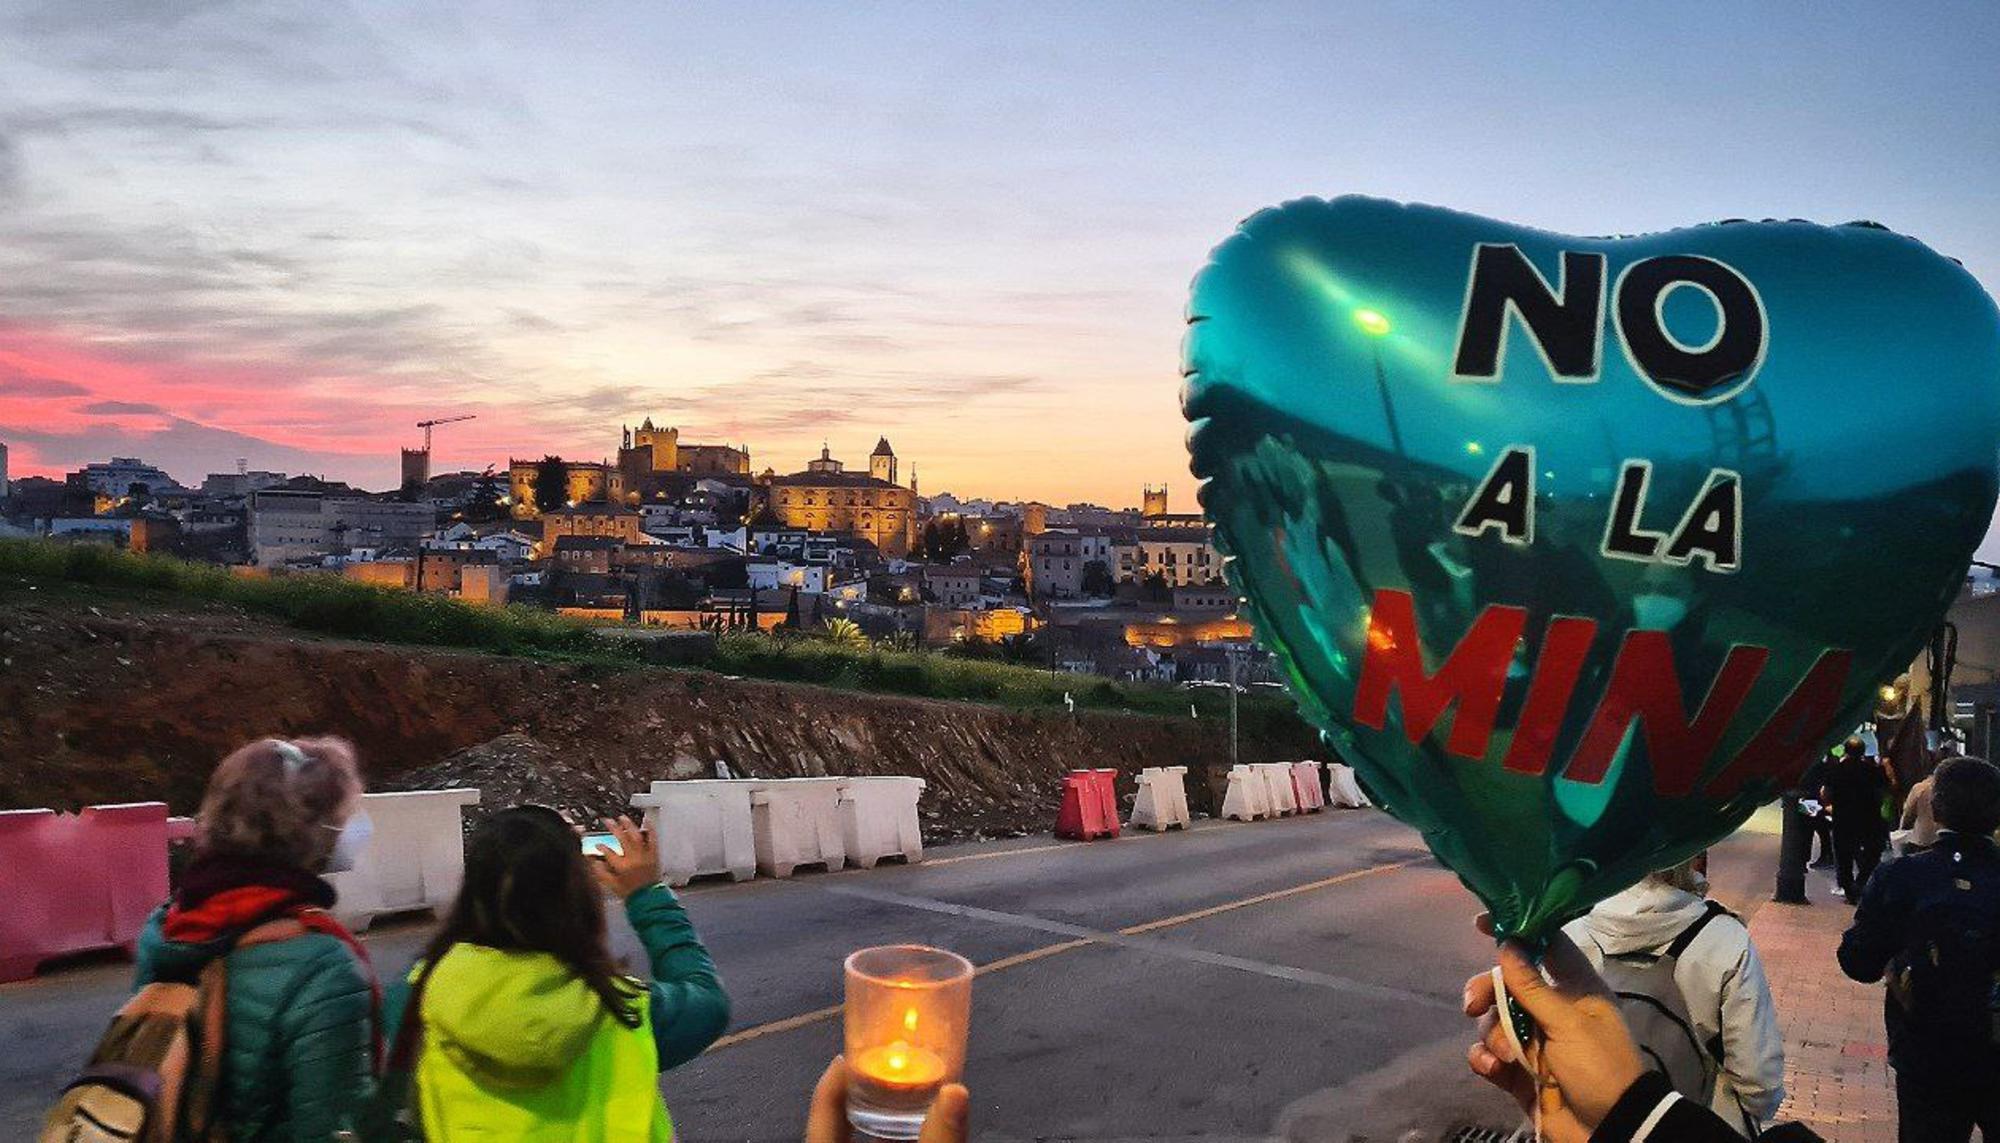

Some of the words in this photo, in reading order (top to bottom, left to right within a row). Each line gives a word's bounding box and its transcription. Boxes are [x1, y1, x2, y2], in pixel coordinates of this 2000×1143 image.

[1452, 242, 1769, 406] NO
[1453, 445, 1536, 545] A
[1601, 457, 1743, 574] LA
[1352, 589, 1853, 796] MINA
